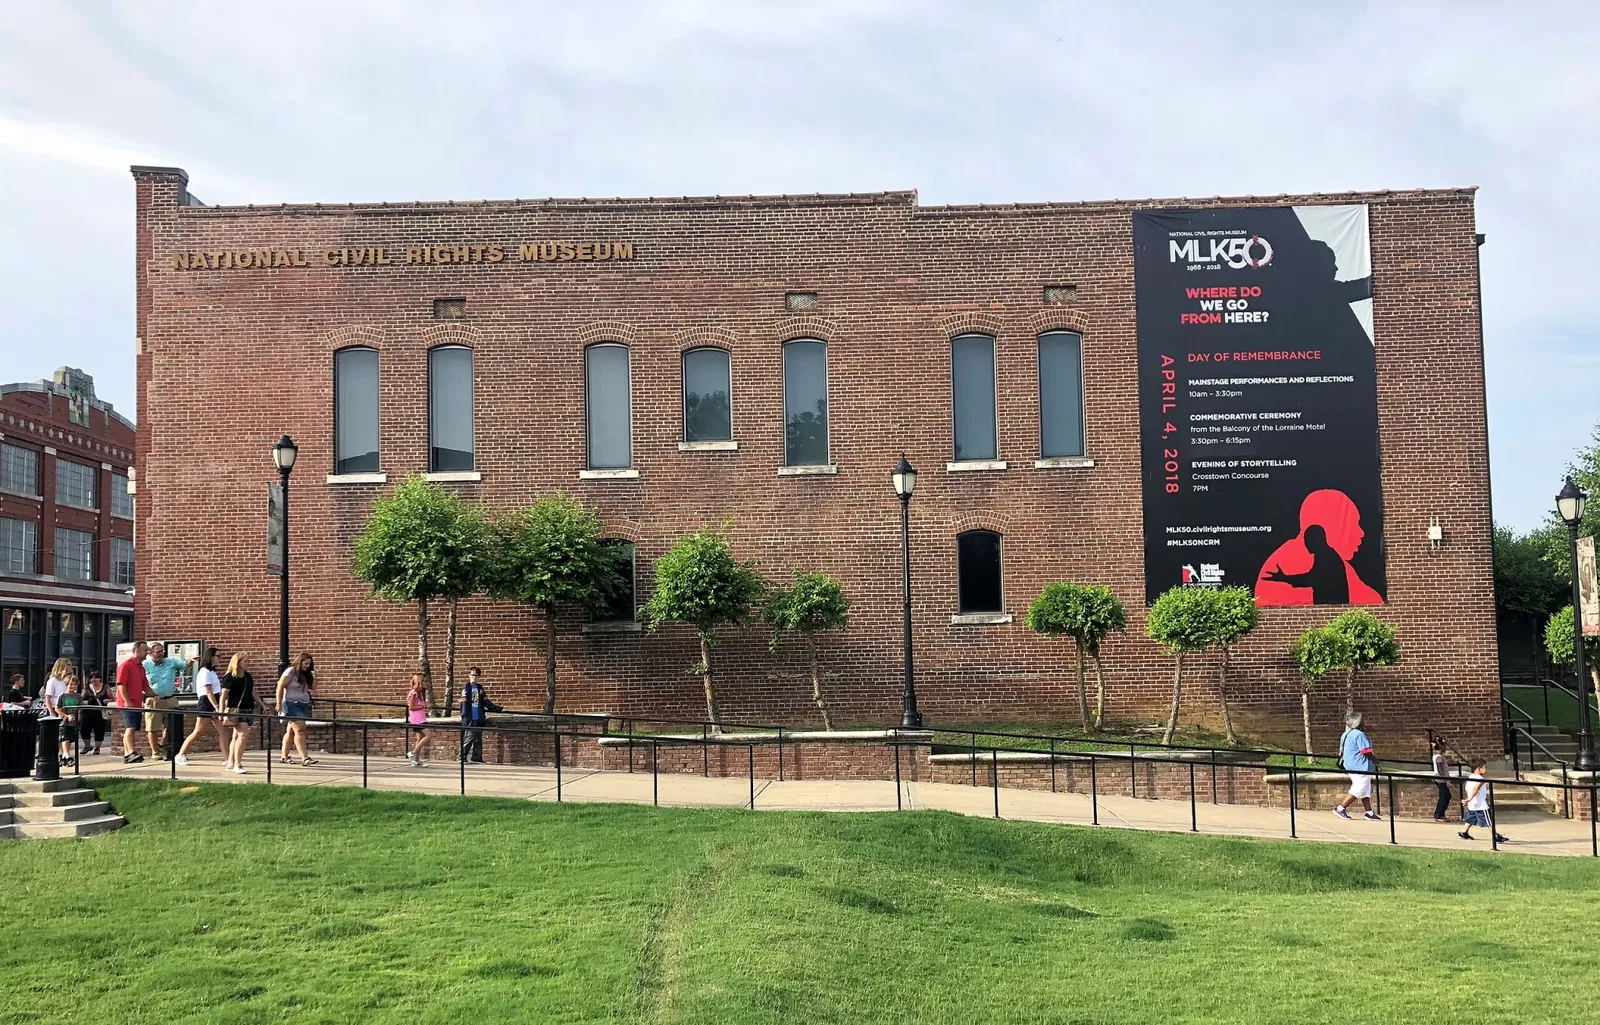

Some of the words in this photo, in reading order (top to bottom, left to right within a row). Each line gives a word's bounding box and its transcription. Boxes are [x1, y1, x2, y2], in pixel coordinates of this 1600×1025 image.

[172, 248, 307, 271] NATIONAL
[322, 246, 392, 267] CIVIL
[406, 244, 504, 265] RIGHTS
[519, 242, 637, 262] MUSEUM
[1186, 287, 1237, 298] WHERE
[1241, 286, 1261, 297] DO
[1200, 300, 1223, 311] WE
[1226, 299, 1248, 310] GO
[1181, 313, 1221, 324] FROM
[1224, 312, 1269, 323] HERE?
[1188, 353, 1210, 362] DAY
[1214, 353, 1229, 361] OF
[1234, 351, 1320, 360] REMEMBRANCE
[1161, 355, 1176, 413] APRIL
[1190, 413, 1257, 421] COMMEMORATIVE
[1162, 422, 1177, 439] 4,
[1165, 449, 1179, 493] 2018
